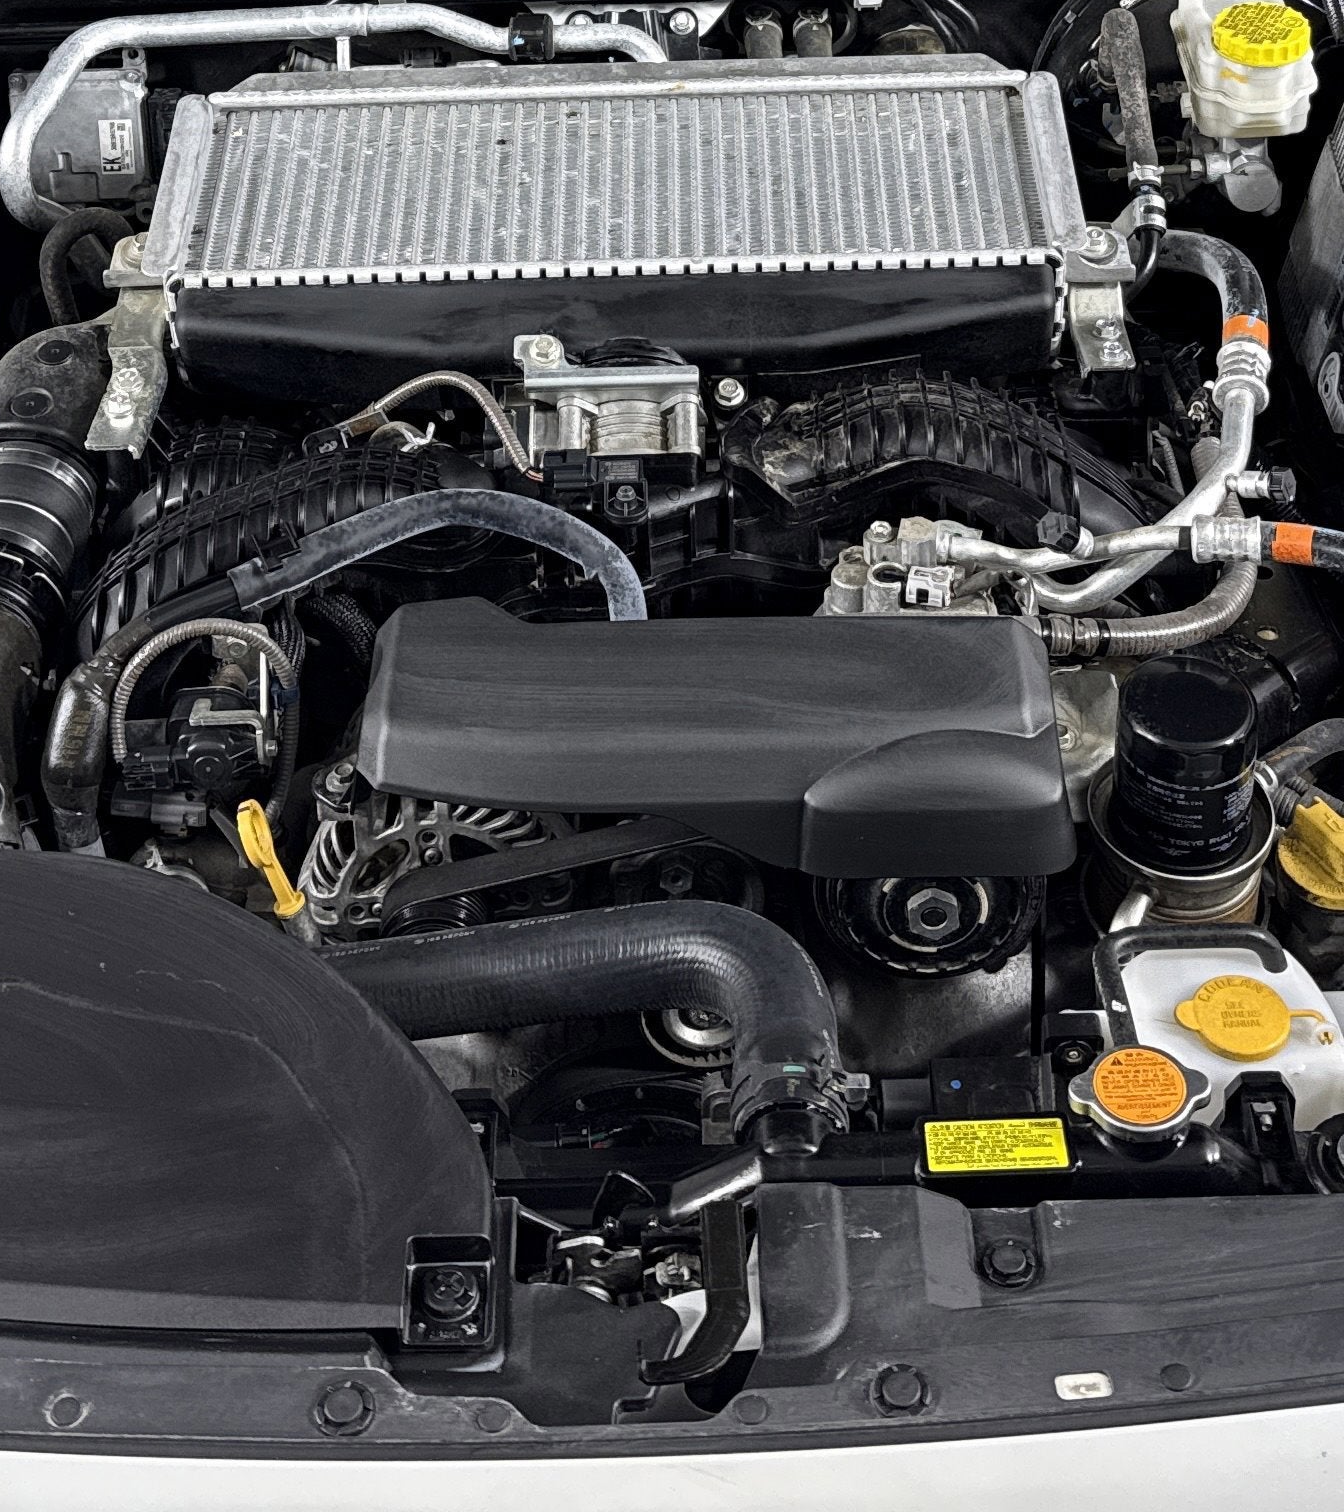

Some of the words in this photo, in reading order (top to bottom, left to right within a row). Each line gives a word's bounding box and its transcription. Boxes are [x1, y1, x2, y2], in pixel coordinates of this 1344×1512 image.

[102, 156, 122, 172] EK
[1169, 837, 1205, 847] TOKYO
[1197, 977, 1276, 1003] COOLANT
